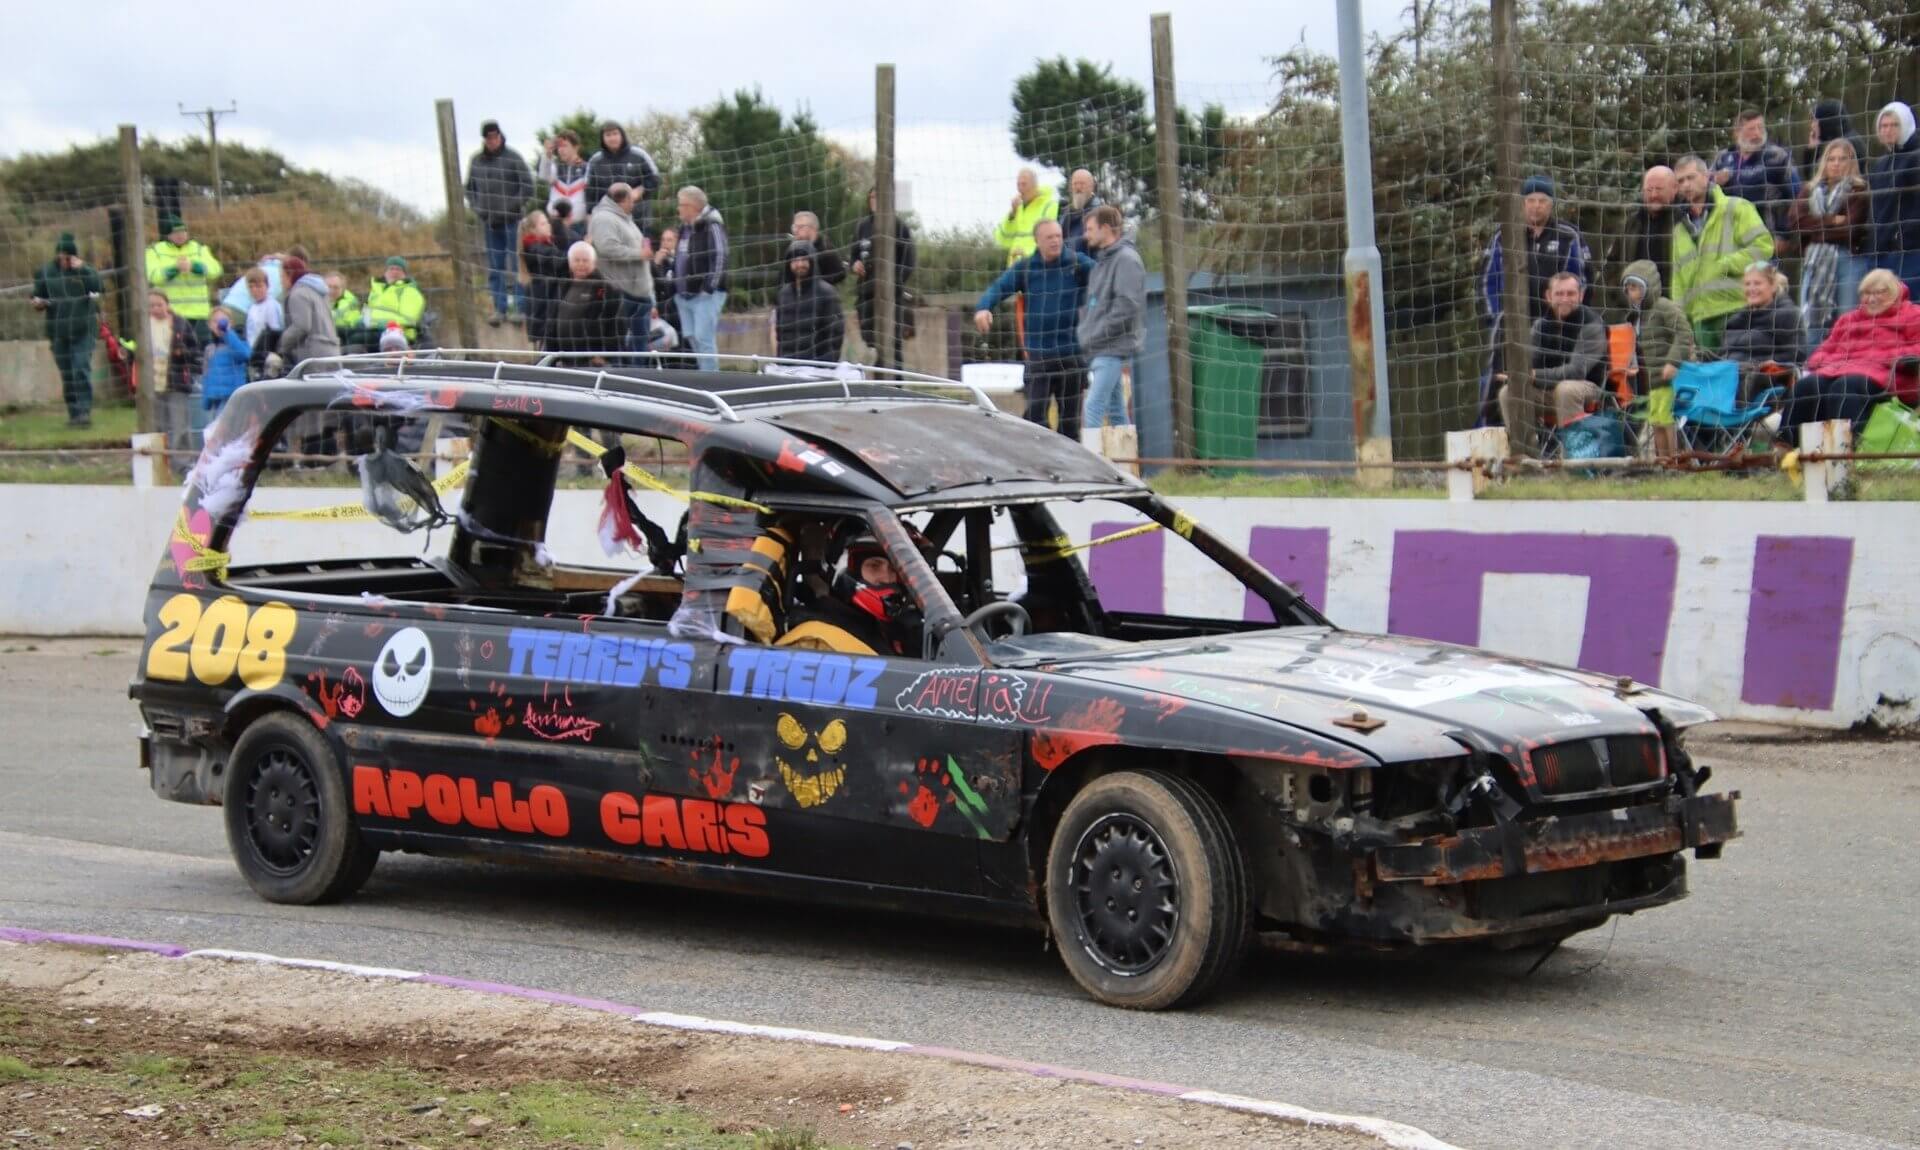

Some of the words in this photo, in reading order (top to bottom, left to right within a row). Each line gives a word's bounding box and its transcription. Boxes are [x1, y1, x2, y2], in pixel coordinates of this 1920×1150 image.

[146, 593, 296, 690] 208
[508, 628, 696, 689] TERRY'S
[728, 647, 888, 709] TREDZ
[353, 765, 569, 837] APOLLO
[600, 791, 770, 858] CARS
